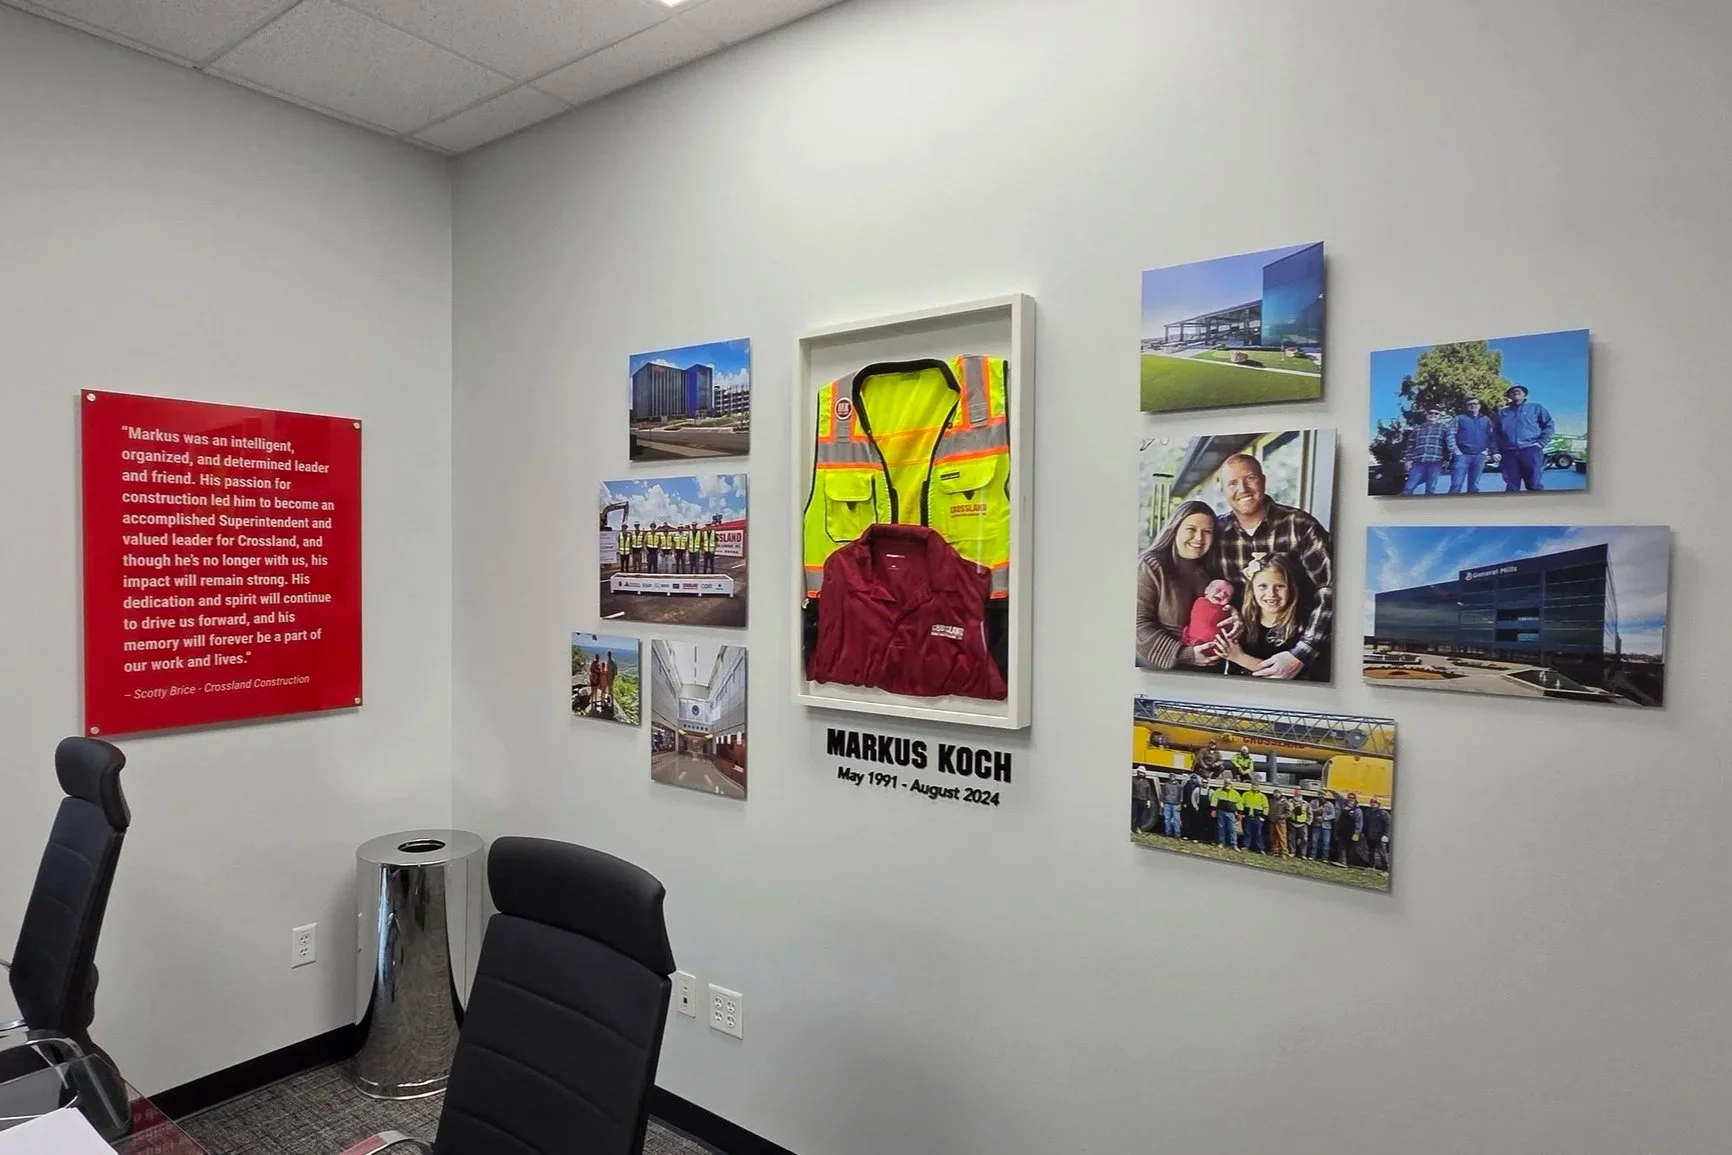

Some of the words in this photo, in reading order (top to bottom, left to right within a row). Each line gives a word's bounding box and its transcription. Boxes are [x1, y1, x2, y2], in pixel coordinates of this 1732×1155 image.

[183, 434, 209, 445] was
[212, 437, 228, 447] an
[231, 435, 294, 454] intelligent,
[121, 450, 193, 467] organized,
[197, 454, 221, 466] and
[223, 455, 292, 471] determined
[295, 460, 329, 473] leader
[122, 469, 148, 482] and
[151, 470, 196, 485] friend.
[200, 473, 221, 486] His
[224, 476, 272, 489] passion
[274, 477, 292, 490] for
[122, 492, 208, 506] construction
[211, 494, 230, 507] led
[233, 494, 256, 507] him
[259, 497, 271, 508] to
[274, 496, 319, 510] become
[321, 502, 335, 510] an
[122, 512, 215, 528] accomplished
[219, 514, 309, 529] Superintendent
[312, 517, 332, 529] and
[122, 532, 168, 545] valued
[172, 533, 213, 546] leader
[216, 534, 235, 546] for
[238, 535, 300, 549] Crossland,
[303, 536, 323, 547] and
[122, 553, 171, 569] though
[203, 557, 219, 566] no
[222, 554, 262, 569] longer
[264, 554, 289, 566] with
[292, 557, 308, 568] us,
[311, 554, 328, 565] his
[123, 575, 170, 590] impact
[174, 574, 197, 587] will
[200, 574, 244, 586] remain
[247, 575, 288, 587] strong.
[292, 573, 310, 584] His
[123, 595, 195, 609] dedication
[198, 594, 221, 606] and
[225, 593, 257, 608] spirit
[260, 592, 280, 604] will
[283, 592, 332, 604] continue
[123, 619, 138, 630] to
[141, 616, 176, 629] drive
[179, 618, 195, 627] us
[198, 613, 250, 626] forward,
[253, 611, 275, 624] and
[278, 611, 295, 623] his
[124, 639, 180, 651] memory
[183, 634, 205, 647] will
[209, 634, 254, 646] forever
[257, 631, 271, 643] be
[274, 633, 281, 642] a
[284, 630, 307, 644] part
[310, 628, 322, 640] of
[124, 662, 148, 672] our
[151, 656, 184, 670] work
[187, 654, 211, 668] and
[134, 688, 167, 699] Scotty
[170, 686, 196, 696] Brice
[204, 679, 252, 692] Crossland
[254, 676, 309, 688] Construction
[827, 728, 928, 769] MARKUS
[938, 743, 1012, 783] KOCH
[837, 766, 864, 783] May
[867, 770, 897, 789] 1991
[910, 780, 960, 800] August
[962, 787, 1000, 806] 2024
